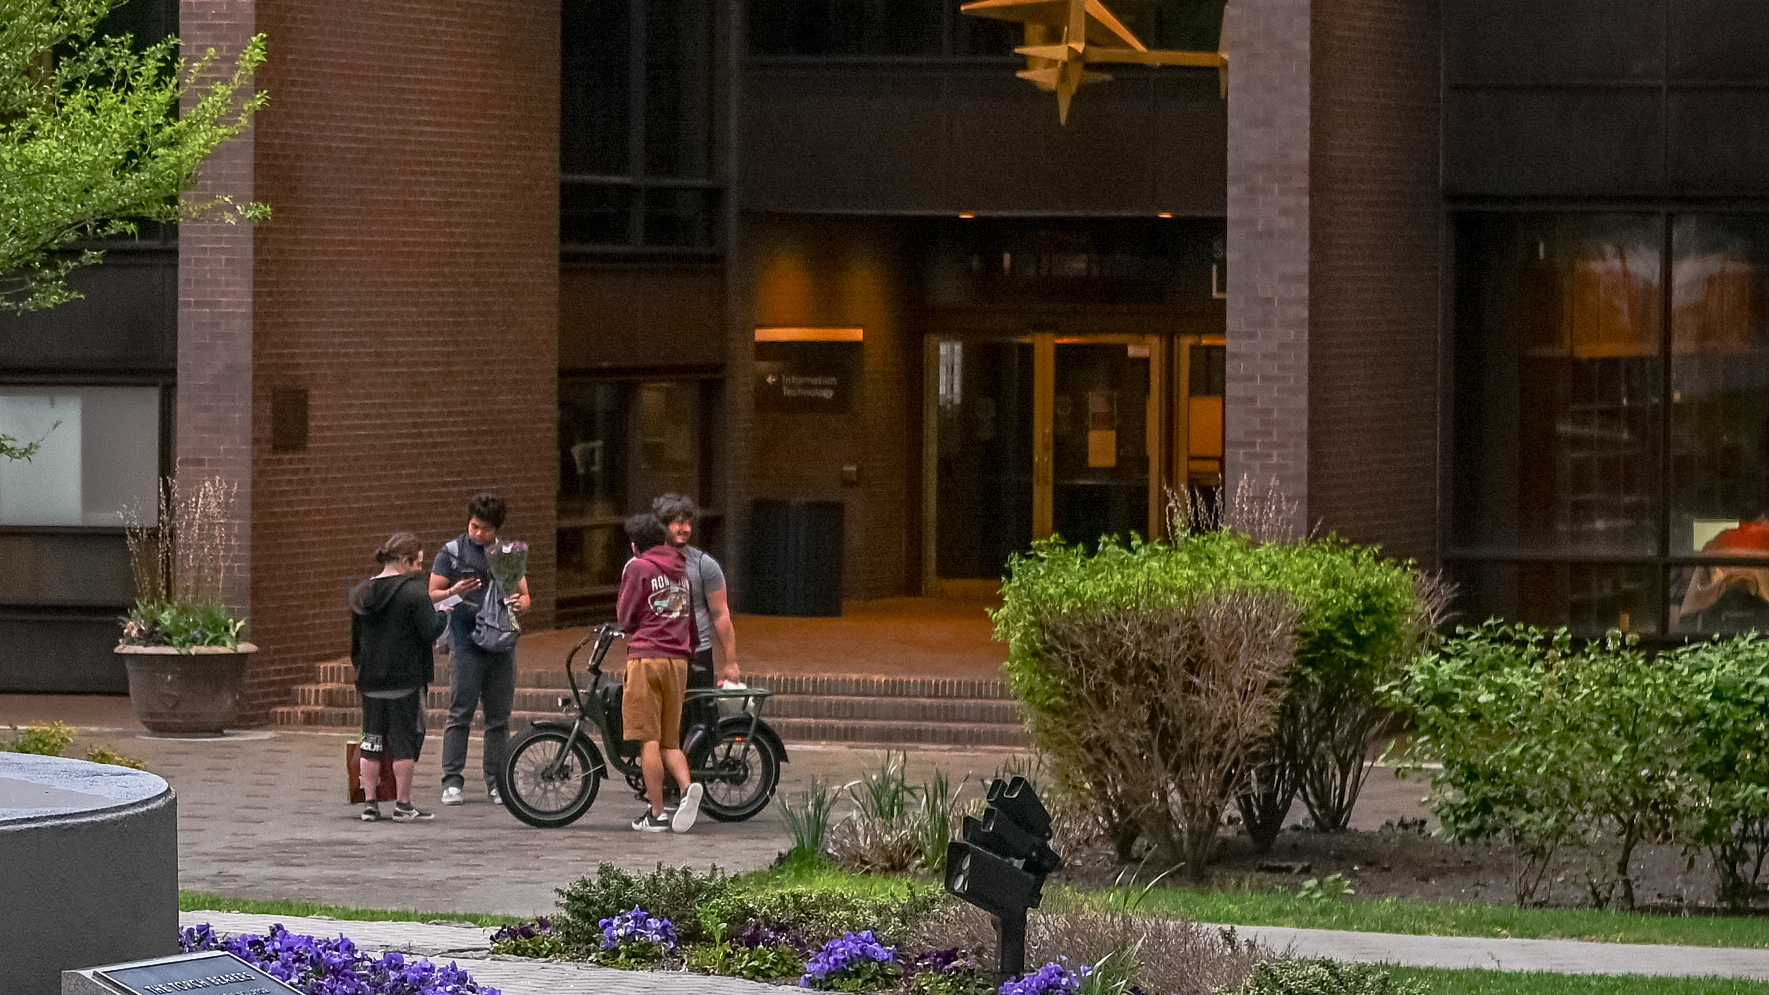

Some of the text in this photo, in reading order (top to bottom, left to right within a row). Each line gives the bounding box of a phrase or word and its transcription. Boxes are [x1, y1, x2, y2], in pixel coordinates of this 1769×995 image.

[782, 374, 837, 385] Information
[782, 386, 834, 399] Technology
[143, 983, 172, 995] THE
[167, 977, 211, 992] TORCH
[206, 971, 256, 986] BEARERS
